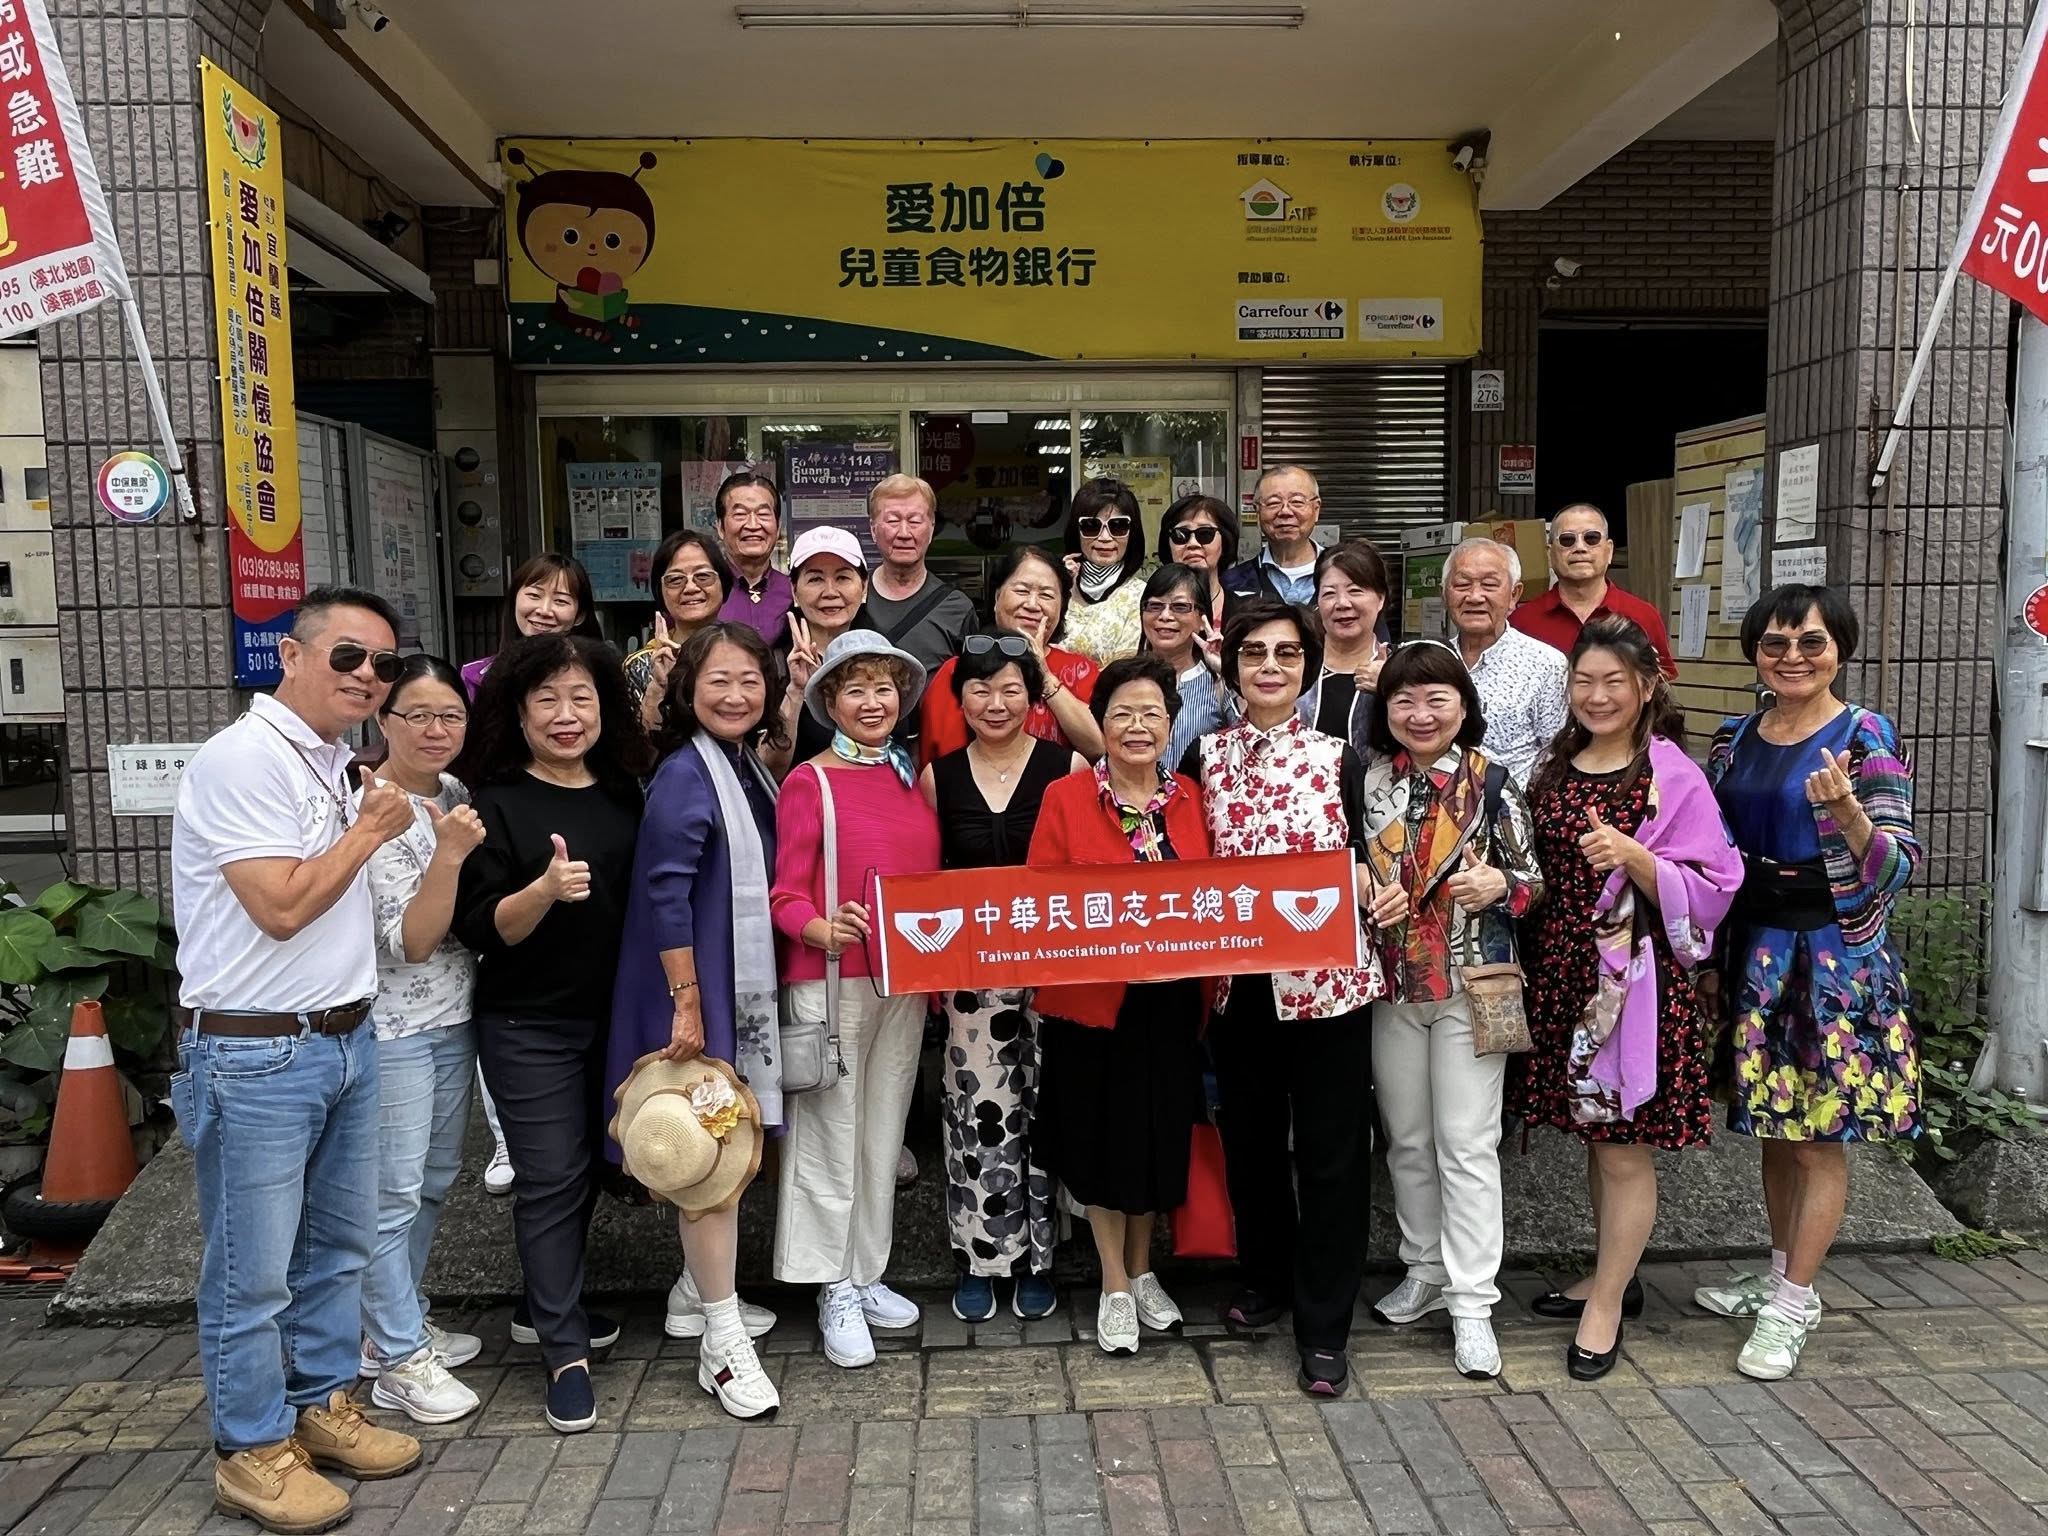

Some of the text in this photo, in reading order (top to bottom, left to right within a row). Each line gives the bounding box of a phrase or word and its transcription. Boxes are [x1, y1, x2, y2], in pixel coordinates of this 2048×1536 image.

[886, 180, 1046, 233] 愛加倍
[0, 255, 95, 300] 95 (溪北地區)
[838, 246, 1096, 288] 兒童食物銀行
[0, 279, 105, 329] 100 (溪南地區)
[1238, 305, 1309, 318] Carrefour
[1366, 314, 1414, 322] FONDATION
[239, 180, 276, 522] 愛加倍關懷協會
[1477, 389, 1499, 403] 276
[791, 465, 831, 478] Guang
[848, 455, 872, 467] 114
[1502, 473, 1532, 481] SECOM
[238, 554, 300, 580] (03)9289-995
[243, 631, 290, 648] 愛心捐款
[247, 652, 284, 671] 5019-
[974, 883, 1260, 936] 中華民國志工總會
[977, 935, 1264, 963] Taiwan Association for Volunteer Effort
